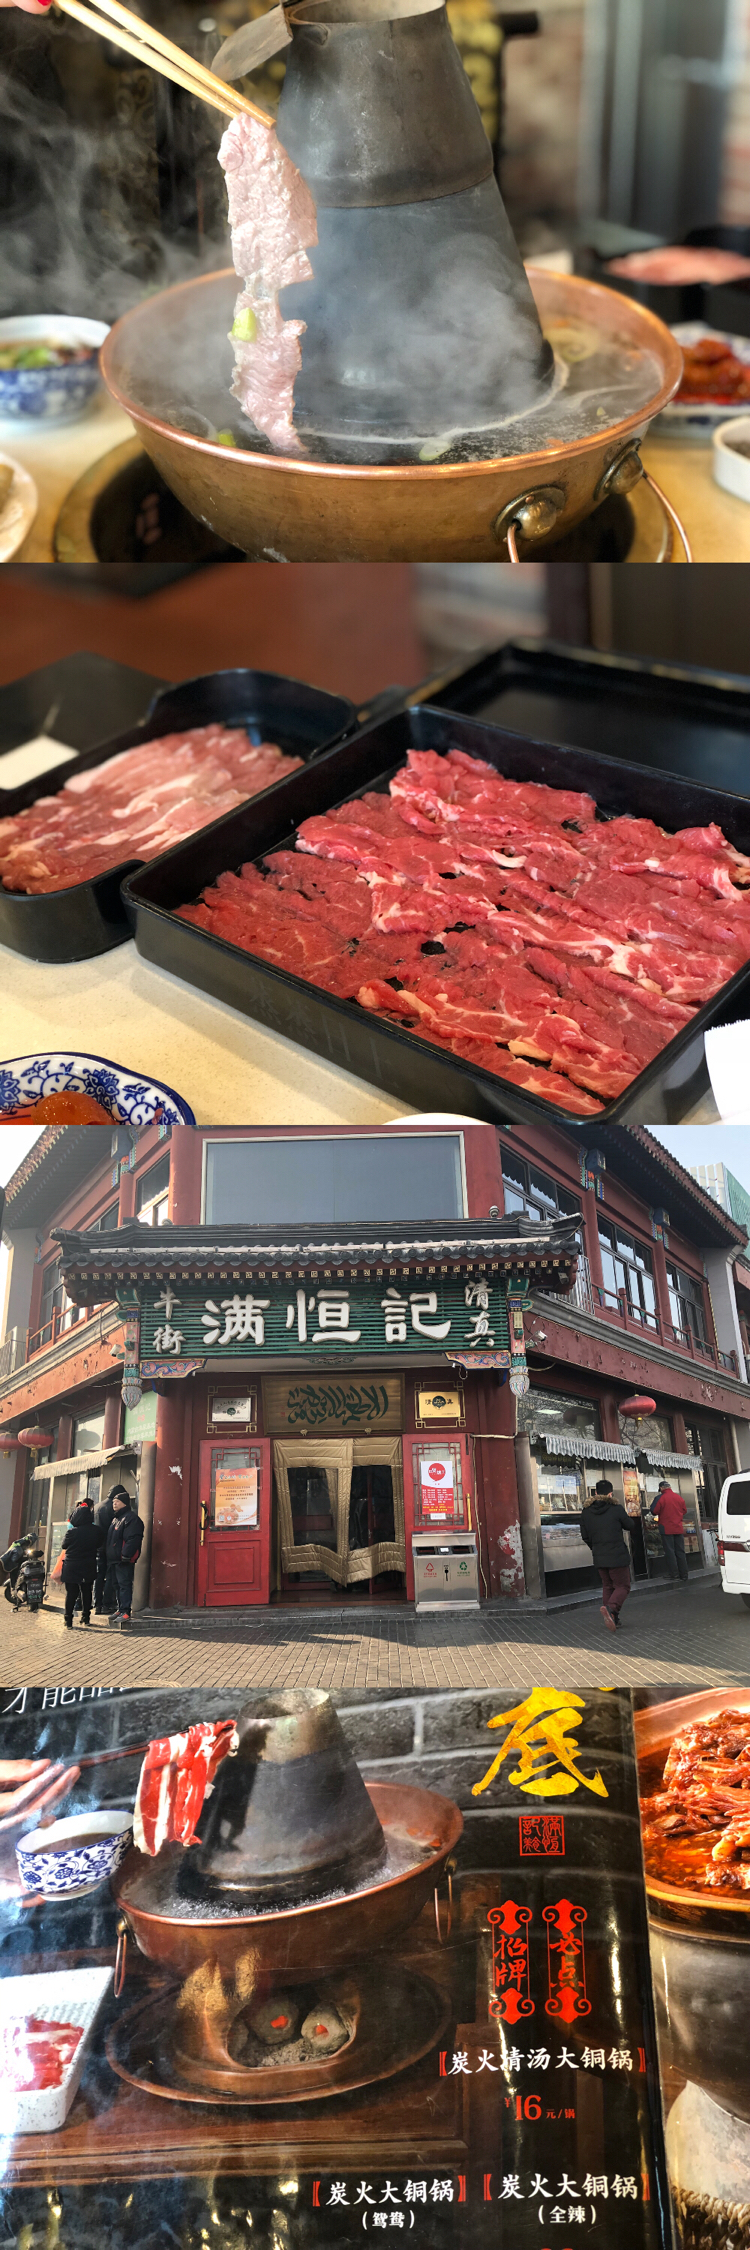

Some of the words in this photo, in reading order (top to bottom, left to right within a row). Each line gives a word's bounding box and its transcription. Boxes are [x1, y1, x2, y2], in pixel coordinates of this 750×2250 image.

[153, 1286, 187, 1355] 牛街
[464, 1278, 496, 1348] 清真
[471, 1687, 609, 1798] 底
[494, 1934, 528, 1992] 招牌
[549, 1932, 585, 1988] 必点
